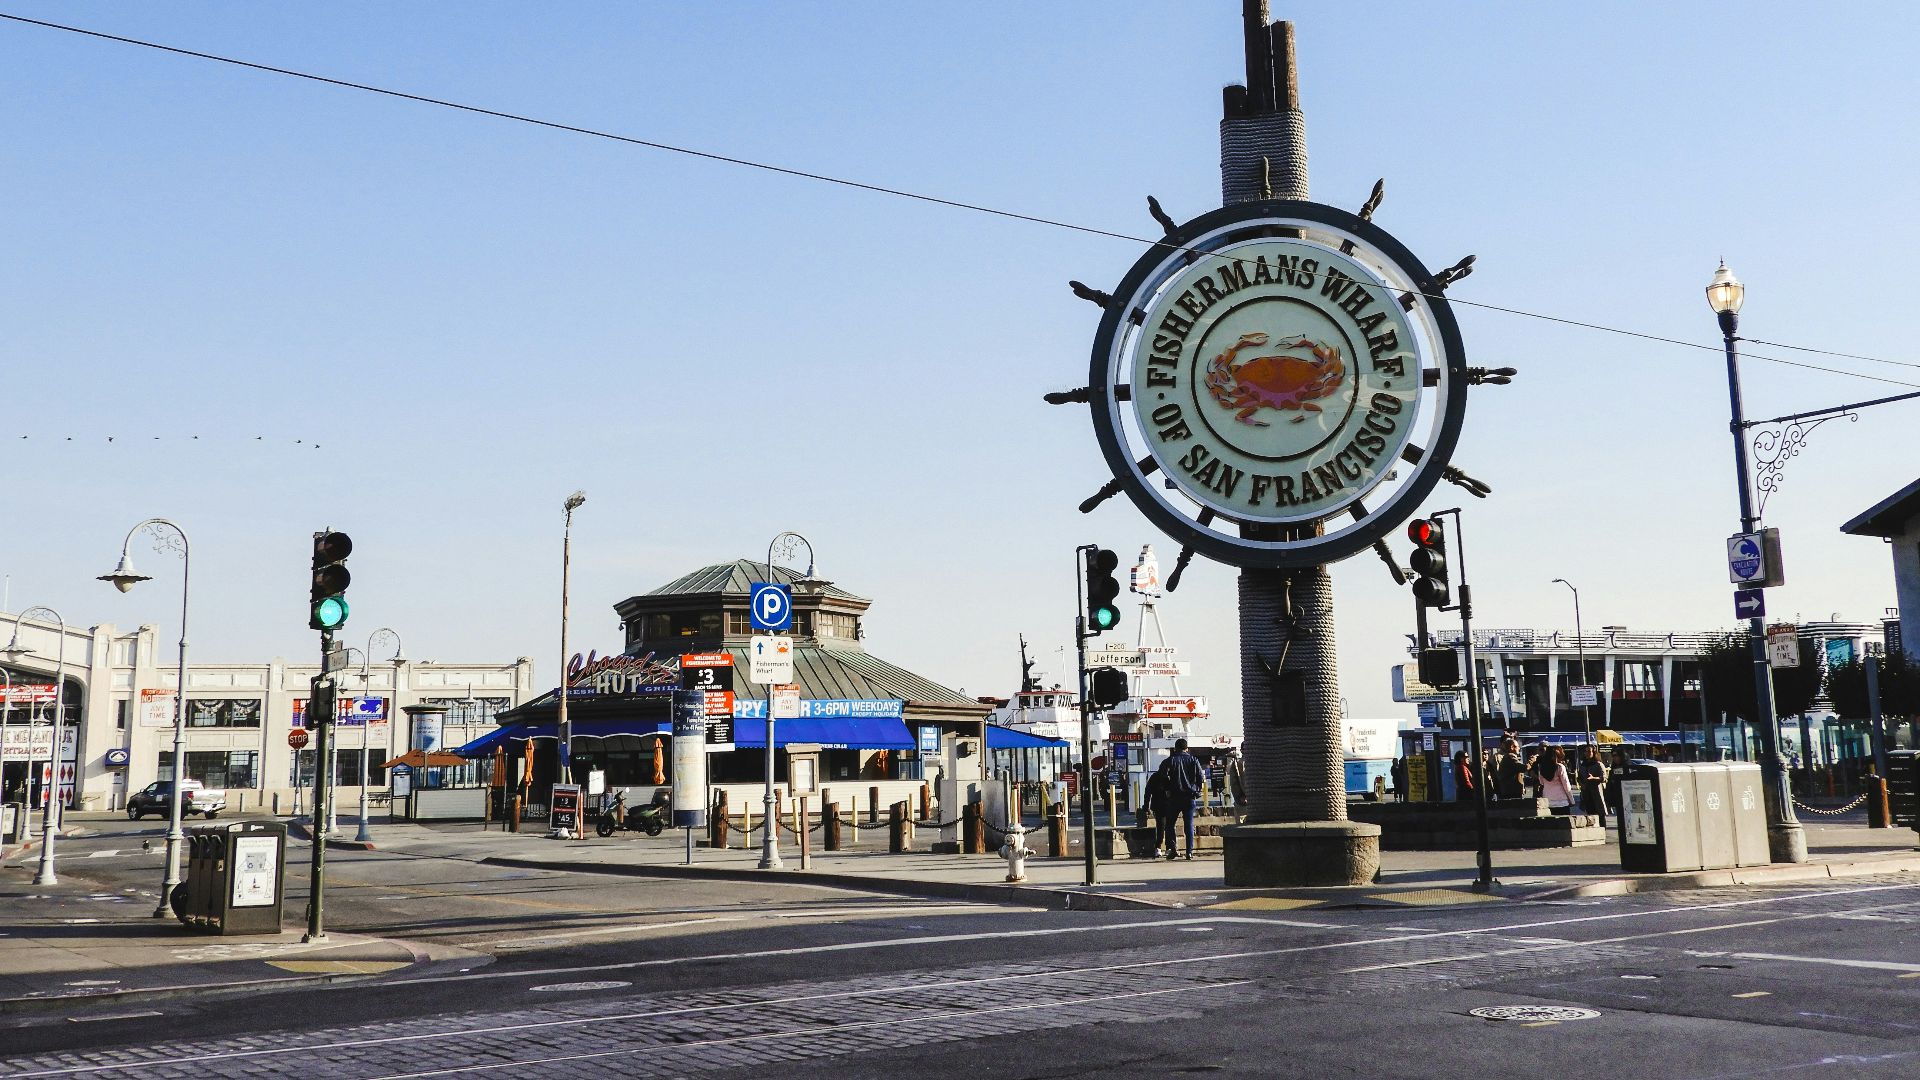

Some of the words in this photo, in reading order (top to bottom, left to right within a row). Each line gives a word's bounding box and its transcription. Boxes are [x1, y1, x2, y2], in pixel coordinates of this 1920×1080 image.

[1146, 254, 1320, 389] FISHERMANS
[1320, 265, 1405, 378] WHARF
[1151, 402, 1193, 443] OF
[1178, 443, 1245, 499] SAN
[1247, 391, 1403, 508] FRANCISCO
[1093, 654, 1141, 664] Jefferson
[595, 671, 642, 694] HUT
[141, 694, 153, 703] NO
[733, 701, 763, 717] PPY
[814, 701, 849, 715] 3-6PM
[852, 702, 900, 711] WEEKDAYS
[289, 735, 308, 743] STOP
